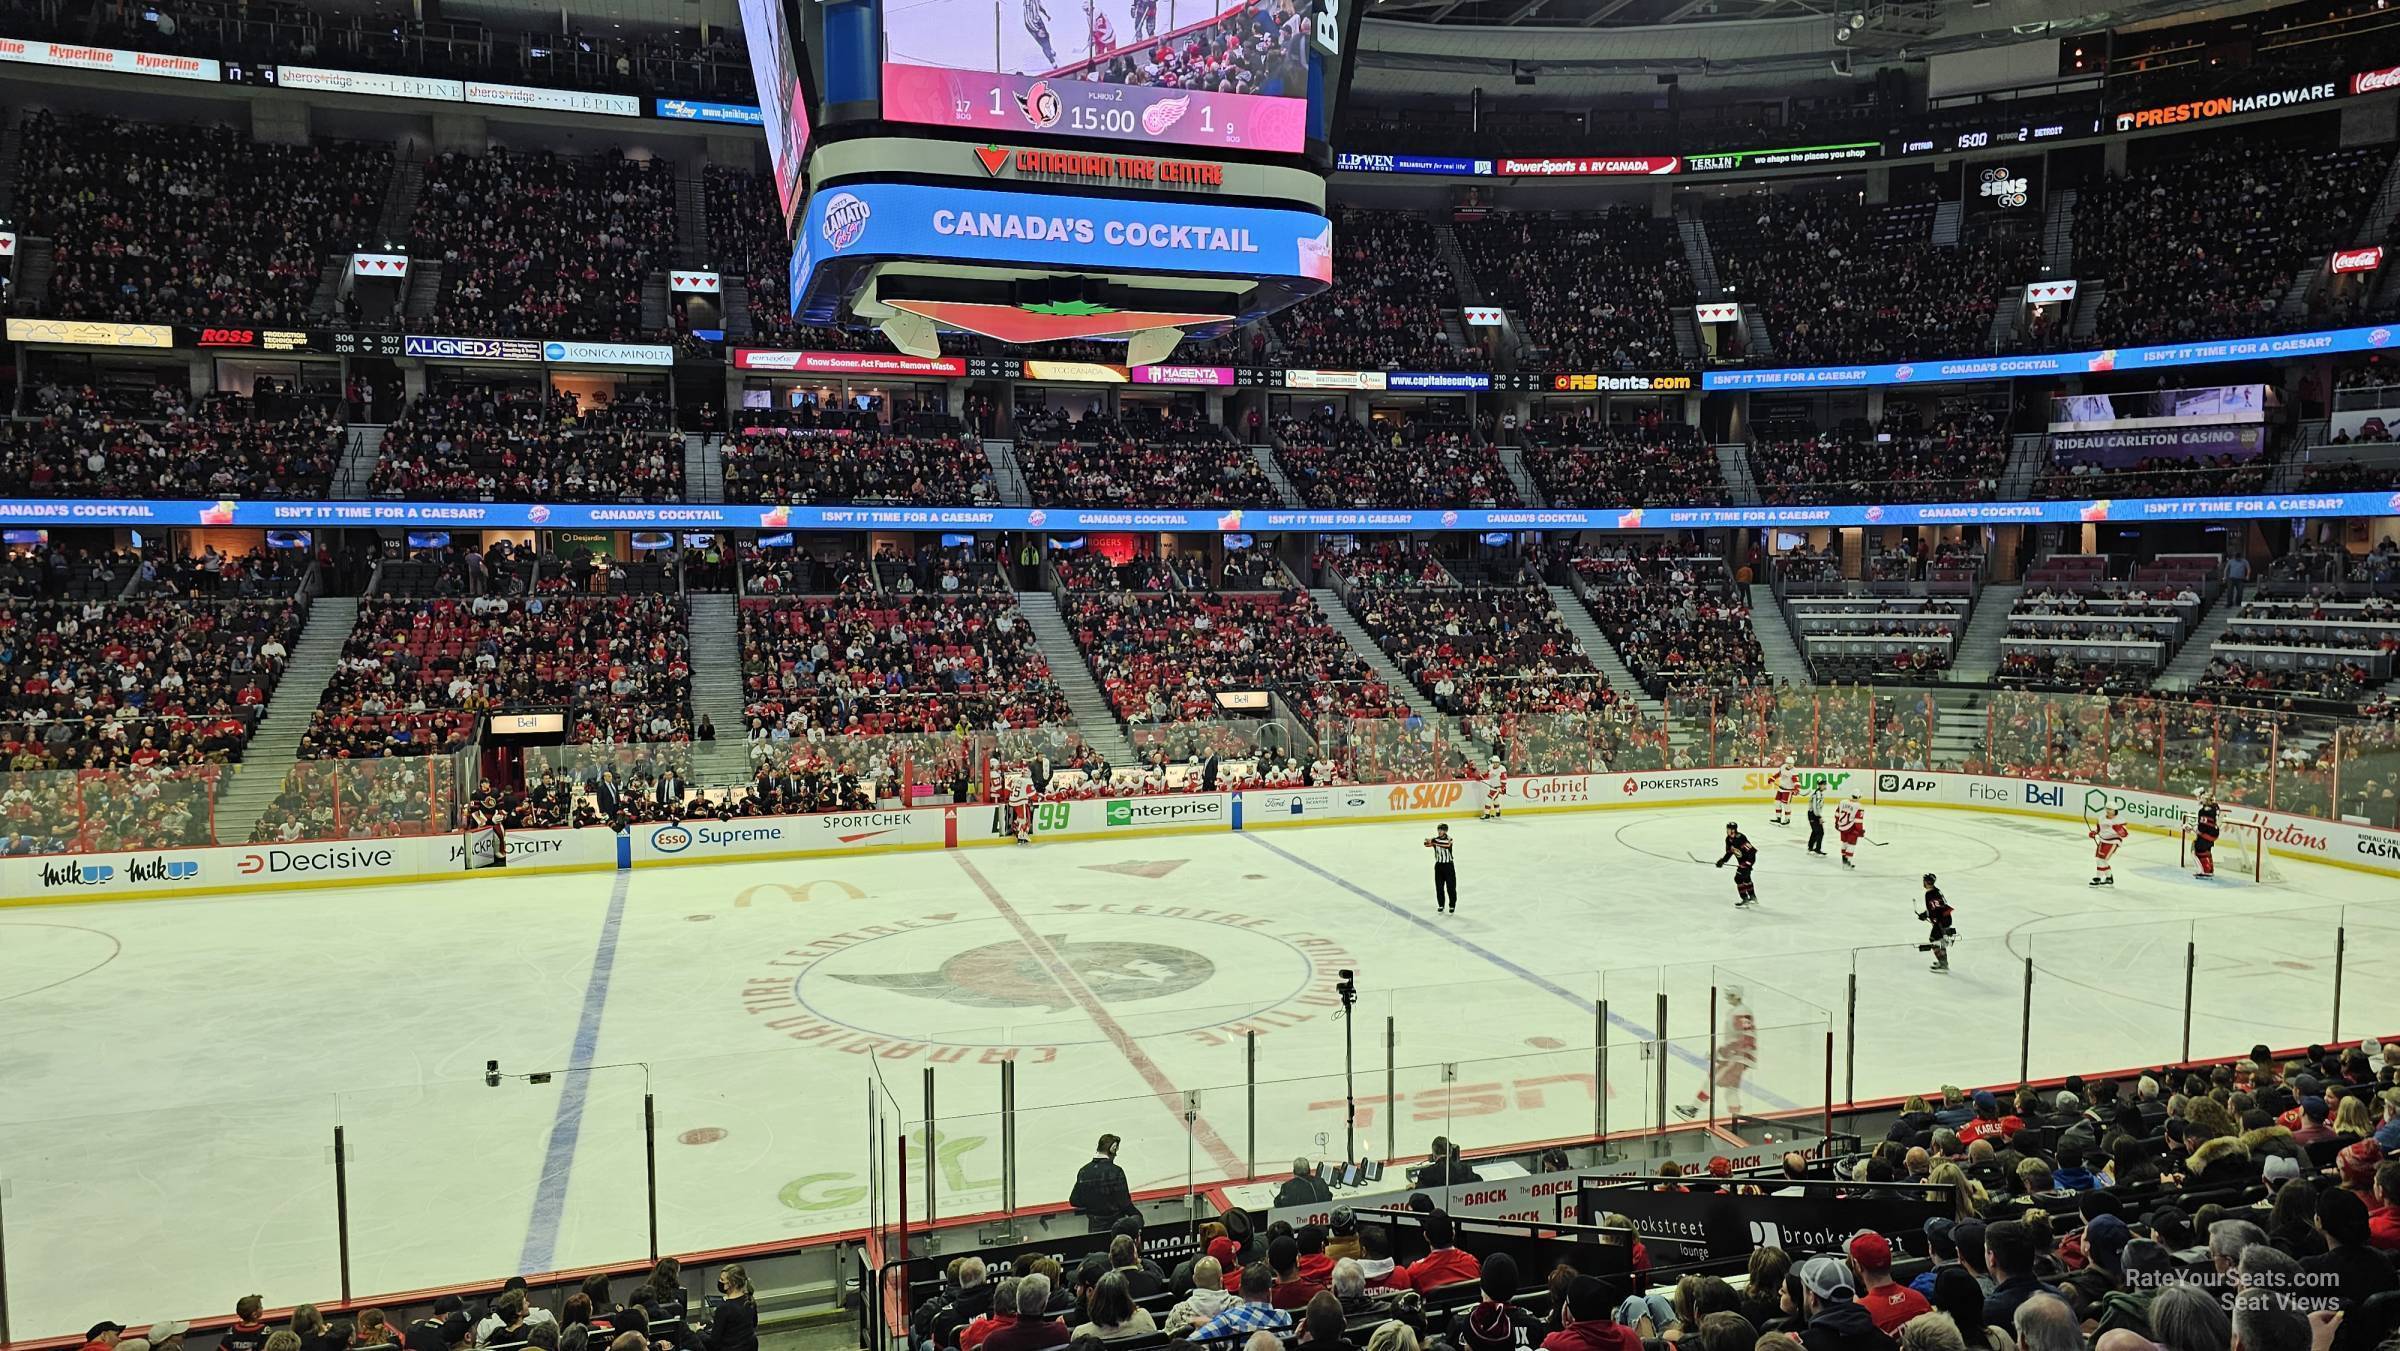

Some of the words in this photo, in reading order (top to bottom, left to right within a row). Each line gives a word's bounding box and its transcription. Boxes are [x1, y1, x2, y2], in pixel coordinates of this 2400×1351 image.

[1316, 0, 1339, 54] Be
[49, 44, 113, 63] Hyperline
[136, 53, 199, 72] Hyperline
[229, 67, 241, 81] 17
[264, 70, 274, 83] 9
[389, 79, 461, 98] LÉPINE
[1116, 90, 1123, 102] 2
[569, 95, 637, 113] LÉPINE
[956, 100, 971, 112] 17
[989, 87, 1005, 116] 1
[1071, 106, 1135, 133] 15:00
[1200, 105, 1215, 133] 1
[1227, 122, 1234, 135] 9
[2018, 128, 2028, 142] 2
[2034, 126, 2063, 138] DETROIT
[1958, 132, 1987, 148] 15:00
[1690, 156, 1732, 167] TERLIN
[1767, 155, 1790, 164] shape
[1790, 154, 1803, 162] the
[1804, 152, 1829, 162] places
[1830, 152, 1845, 161] you
[1846, 149, 1866, 159] shop
[1016, 150, 1113, 177] CANADIAN
[1116, 157, 1155, 180] TIRE
[1160, 161, 1223, 186] CENTRE
[1506, 160, 1576, 174] PowerSports
[1579, 162, 1587, 172] &
[1591, 162, 1606, 172] RV
[1607, 161, 1649, 172] CANADA
[1980, 167, 2009, 183] GO
[1979, 177, 2028, 197] SENS
[1997, 192, 2028, 208] GO
[933, 209, 1094, 243] CANADA'S
[1104, 221, 1259, 253] COCKTAIL
[202, 328, 254, 342] ROSS
[335, 334, 354, 343] 306
[381, 335, 399, 344] 307
[408, 339, 487, 356] ALIGNED
[570, 347, 617, 358] KONICA
[620, 350, 673, 361] MINOLTA
[2144, 351, 2176, 362] ISN'T
[2179, 349, 2192, 359] IT
[2195, 346, 2226, 357] TIME
[2230, 343, 2257, 354] FOR
[2259, 342, 2271, 352] A
[2272, 337, 2332, 351] CAESAR?
[807, 357, 830, 367] Know
[831, 358, 859, 368] Sooner.
[861, 359, 874, 368] Act
[875, 359, 899, 369] Faster.
[901, 361, 930, 370] Remove
[931, 362, 956, 371] Waste.
[1941, 362, 1997, 375] CANADA'S
[2001, 360, 2058, 371] COCKTAIL
[1163, 367, 1218, 379] MAGENTA
[1713, 376, 1741, 385] ISN'T
[1743, 375, 1755, 385] IT
[1756, 374, 1782, 384] TIME
[1784, 373, 1805, 382] FOR
[1807, 372, 1816, 381] A
[1818, 370, 1866, 381] CAESAR?
[1391, 375, 1489, 388] www.capitalsecurity.ca
[2055, 437, 2104, 450] RIDEAU
[2107, 433, 2178, 448] CARLETON
[2181, 430, 2235, 444] CASINO
[0, 505, 69, 516] ANADA'S
[73, 505, 154, 517] COCKTAIL
[275, 507, 313, 517] ISN'T
[317, 507, 332, 517] IT
[335, 507, 371, 518] TIME
[375, 507, 403, 518] FOR
[407, 507, 419, 518] A
[421, 508, 486, 519] CAESAR?
[1919, 508, 1978, 518] CANADA'S
[1981, 507, 2043, 517] COCKTAIL
[2144, 503, 2179, 514] ISN'T
[2182, 502, 2195, 512] IT
[2199, 501, 2233, 512] TIME
[2236, 500, 2264, 511] FOR
[2267, 500, 2277, 511] A
[2281, 499, 2344, 511] CAESAR?
[591, 509, 655, 520] CANADA'S
[659, 510, 723, 520] COCKTAIL
[822, 511, 852, 521] ISN'T
[856, 512, 868, 522] IT
[872, 512, 900, 522] TIME
[904, 512, 927, 522] FOR
[930, 512, 939, 522] A
[942, 512, 994, 523] CAESAR?
[1079, 515, 1132, 525] CANADA'S
[1134, 515, 1187, 525] COCKTAIL
[1269, 515, 1295, 524] ISN'T
[1297, 515, 1307, 524] IT
[1309, 515, 1334, 524] TIME
[1336, 515, 1356, 524] FOR
[1358, 515, 1366, 524] A
[1368, 514, 1412, 524] CAESAR?
[1487, 514, 1535, 524] CANADA'S
[1538, 514, 1588, 523] COCKTAIL
[1671, 512, 1697, 521] ISN'T
[1700, 512, 1710, 521] IT
[1712, 511, 1740, 521] TIME
[1743, 511, 1766, 521] FOR
[1769, 511, 1778, 520] A
[1780, 509, 1831, 520] CAESAR?
[384, 540, 400, 548] 105
[738, 541, 753, 549] 106
[1261, 542, 1273, 550] 107
[1234, 694, 1249, 703] Bell
[517, 717, 537, 728] Bell
[1523, 776, 1588, 800] Gabriel
[1640, 777, 1719, 790] POKERSTARS
[1742, 772, 1850, 792] SUWAY
[1409, 783, 1463, 809] SKIP
[1543, 793, 1588, 802] PIZZA
[1969, 782, 2008, 801] Fibe
[2025, 783, 2065, 807] Bell
[1112, 800, 1220, 819] enterprise
[823, 813, 912, 829] SPORTCHEK
[658, 833, 686, 845] Esso
[698, 827, 782, 847] Supreme
[2357, 841, 2400, 860] CASIN
[269, 846, 392, 872] Decisive
[1100, 903, 1276, 928] CENTRE
[768, 919, 925, 967] CENTRE
[742, 976, 797, 1015] TIRE
[765, 1014, 1058, 1065] CANADIAN
[1974, 1122, 2003, 1136] KARLS
[1520, 1186, 1531, 1195] The
[1531, 1180, 1573, 1197] BRICK
[1452, 1195, 1464, 1204] The
[1464, 1188, 1508, 1206] BRICK
[1633, 1217, 1706, 1237] ookstreet
[1680, 1243, 1710, 1259] lounge
